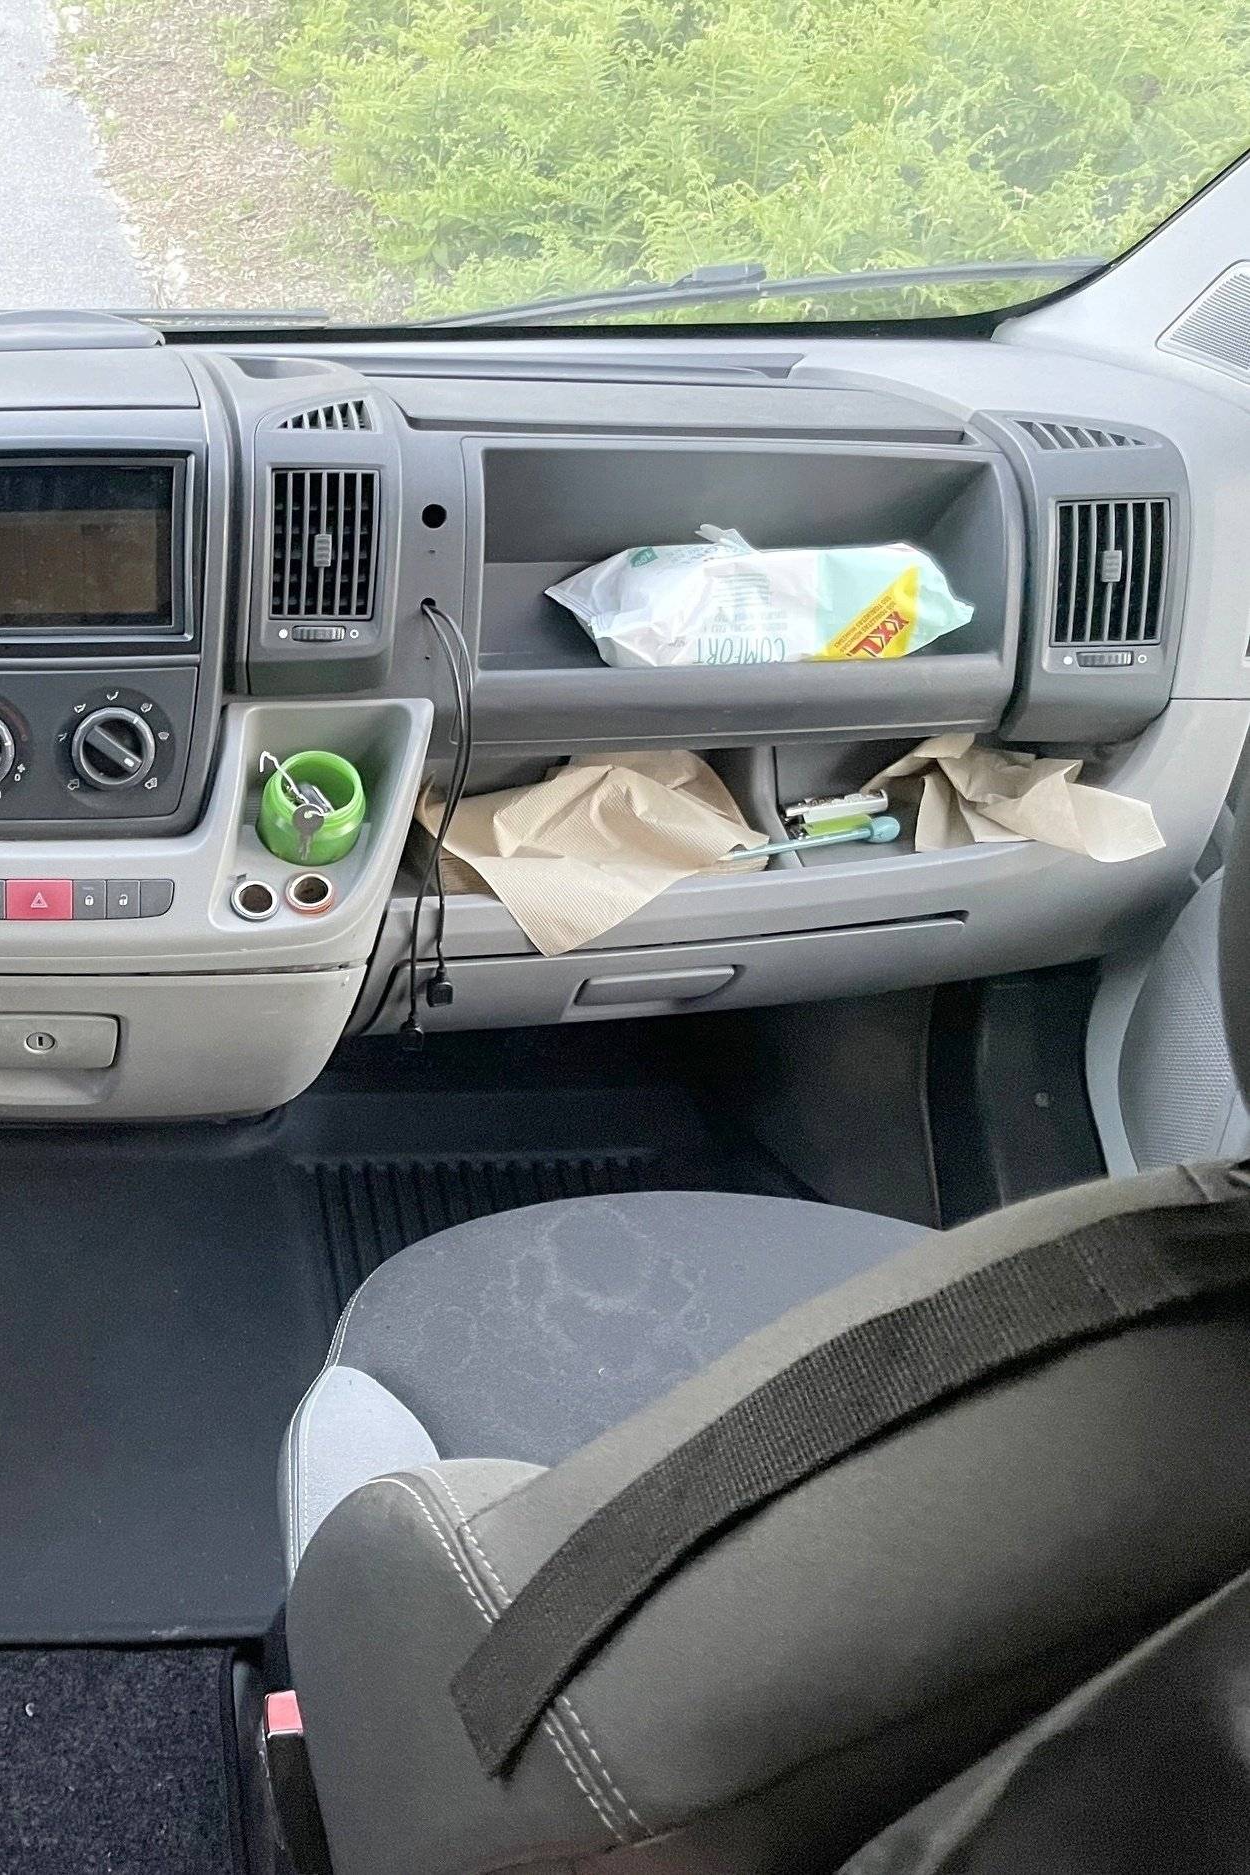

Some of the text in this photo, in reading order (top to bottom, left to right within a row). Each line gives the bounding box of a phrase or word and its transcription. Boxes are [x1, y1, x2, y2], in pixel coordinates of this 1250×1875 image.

[846, 610, 910, 657] XXL
[692, 637, 786, 665] COMFORT
[14, 773, 21, 782] 0
